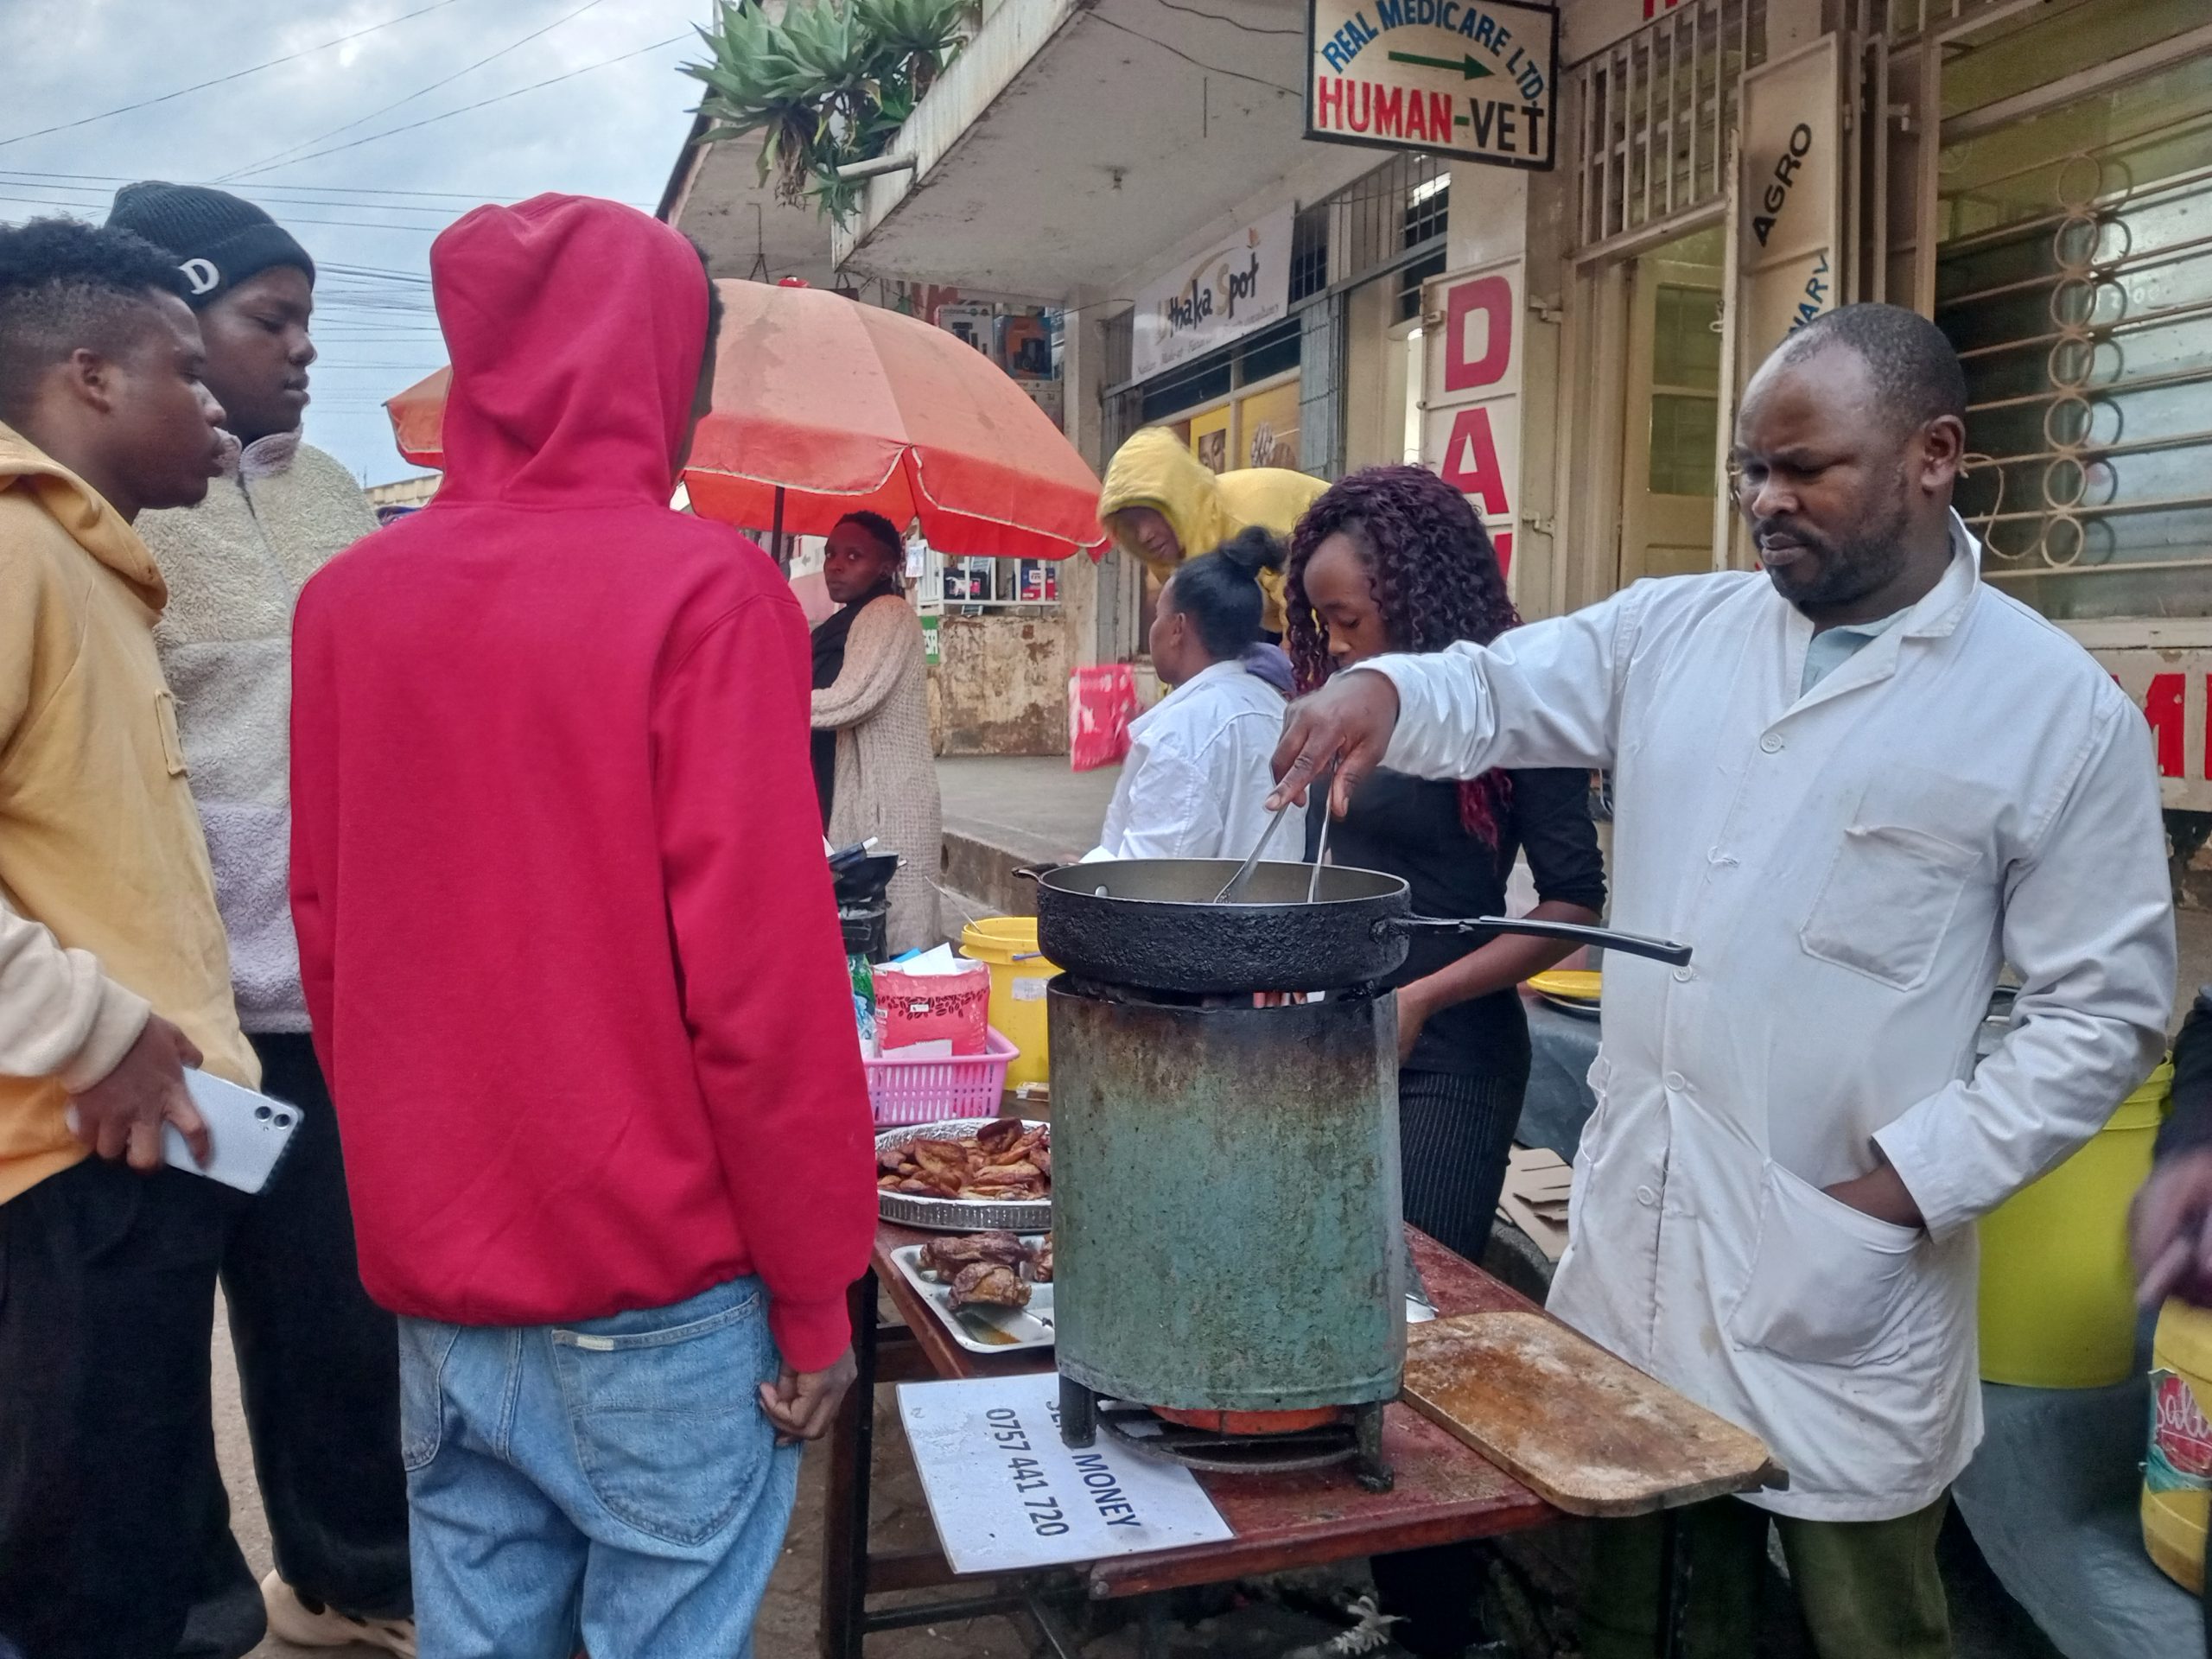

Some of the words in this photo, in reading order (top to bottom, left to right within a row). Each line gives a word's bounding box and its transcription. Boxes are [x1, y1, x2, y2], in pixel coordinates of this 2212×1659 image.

[1321, 11, 1379, 74] REAL
[1376, 0, 1513, 57] MEDICARE
[1319, 76, 1544, 156] HUMAN-VET
[1751, 123, 1812, 248] AGRO
[178, 257, 219, 295] D
[1216, 251, 1260, 320] Spot
[1440, 276, 1513, 585] DA
[986, 1408, 1031, 1451] 0757
[1007, 1457, 1049, 1493] 441
[1071, 1453, 1141, 1527] MONEY
[1024, 1496, 1070, 1536] 720
